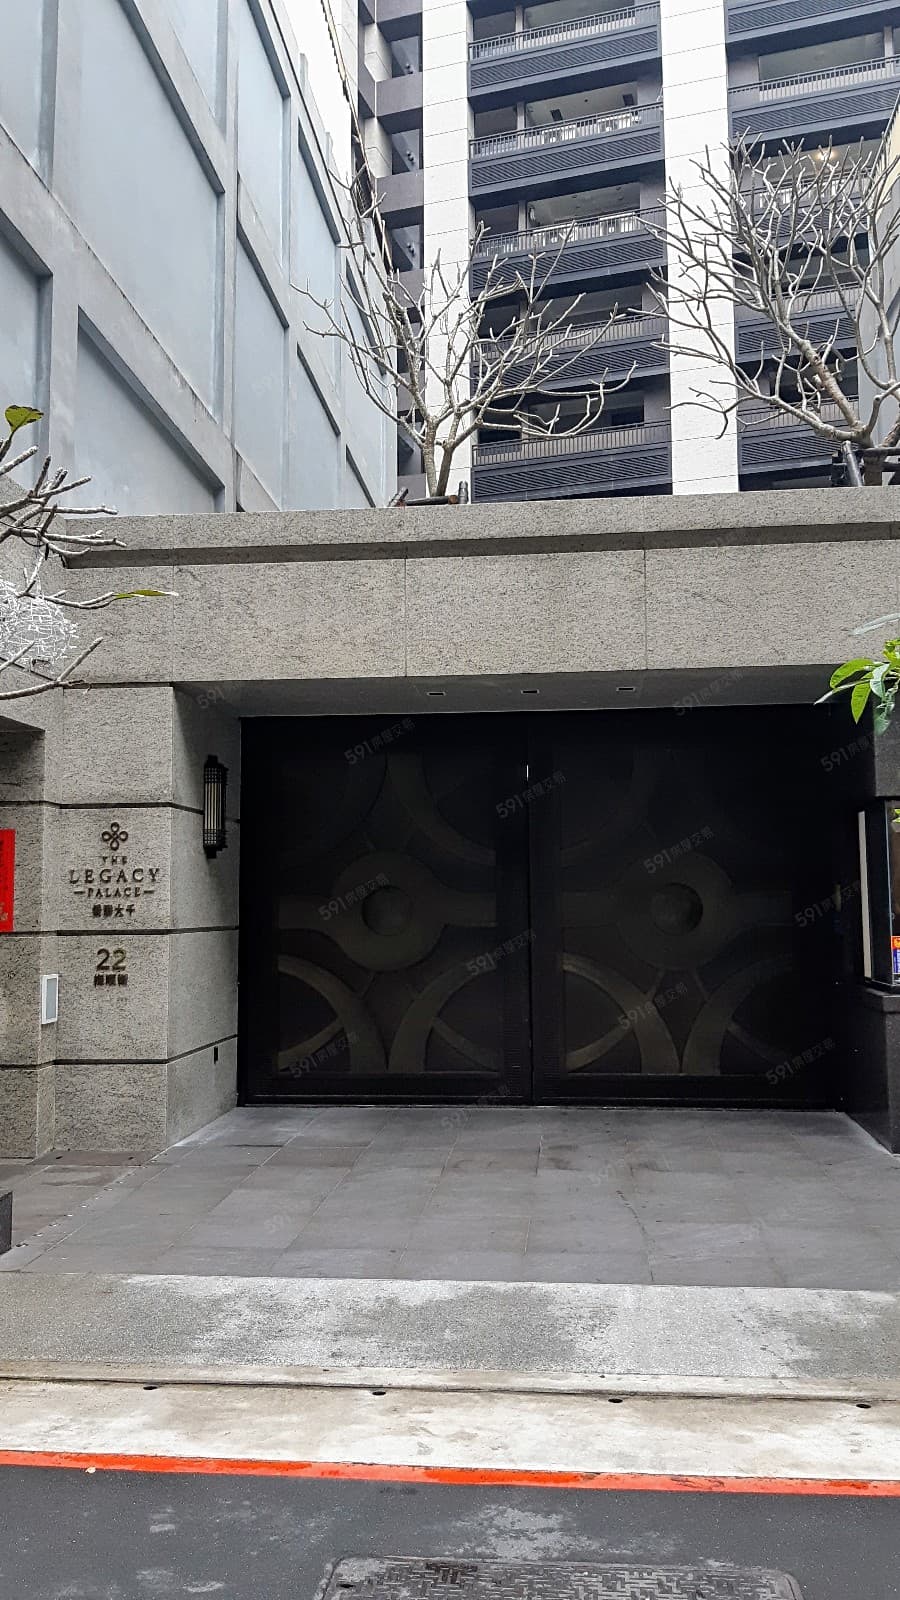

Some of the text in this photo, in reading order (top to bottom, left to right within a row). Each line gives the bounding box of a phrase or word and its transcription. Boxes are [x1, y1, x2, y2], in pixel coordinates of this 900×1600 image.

[102, 855, 128, 866] THE
[69, 867, 160, 884] LEGACY
[97, 949, 127, 971] 22
